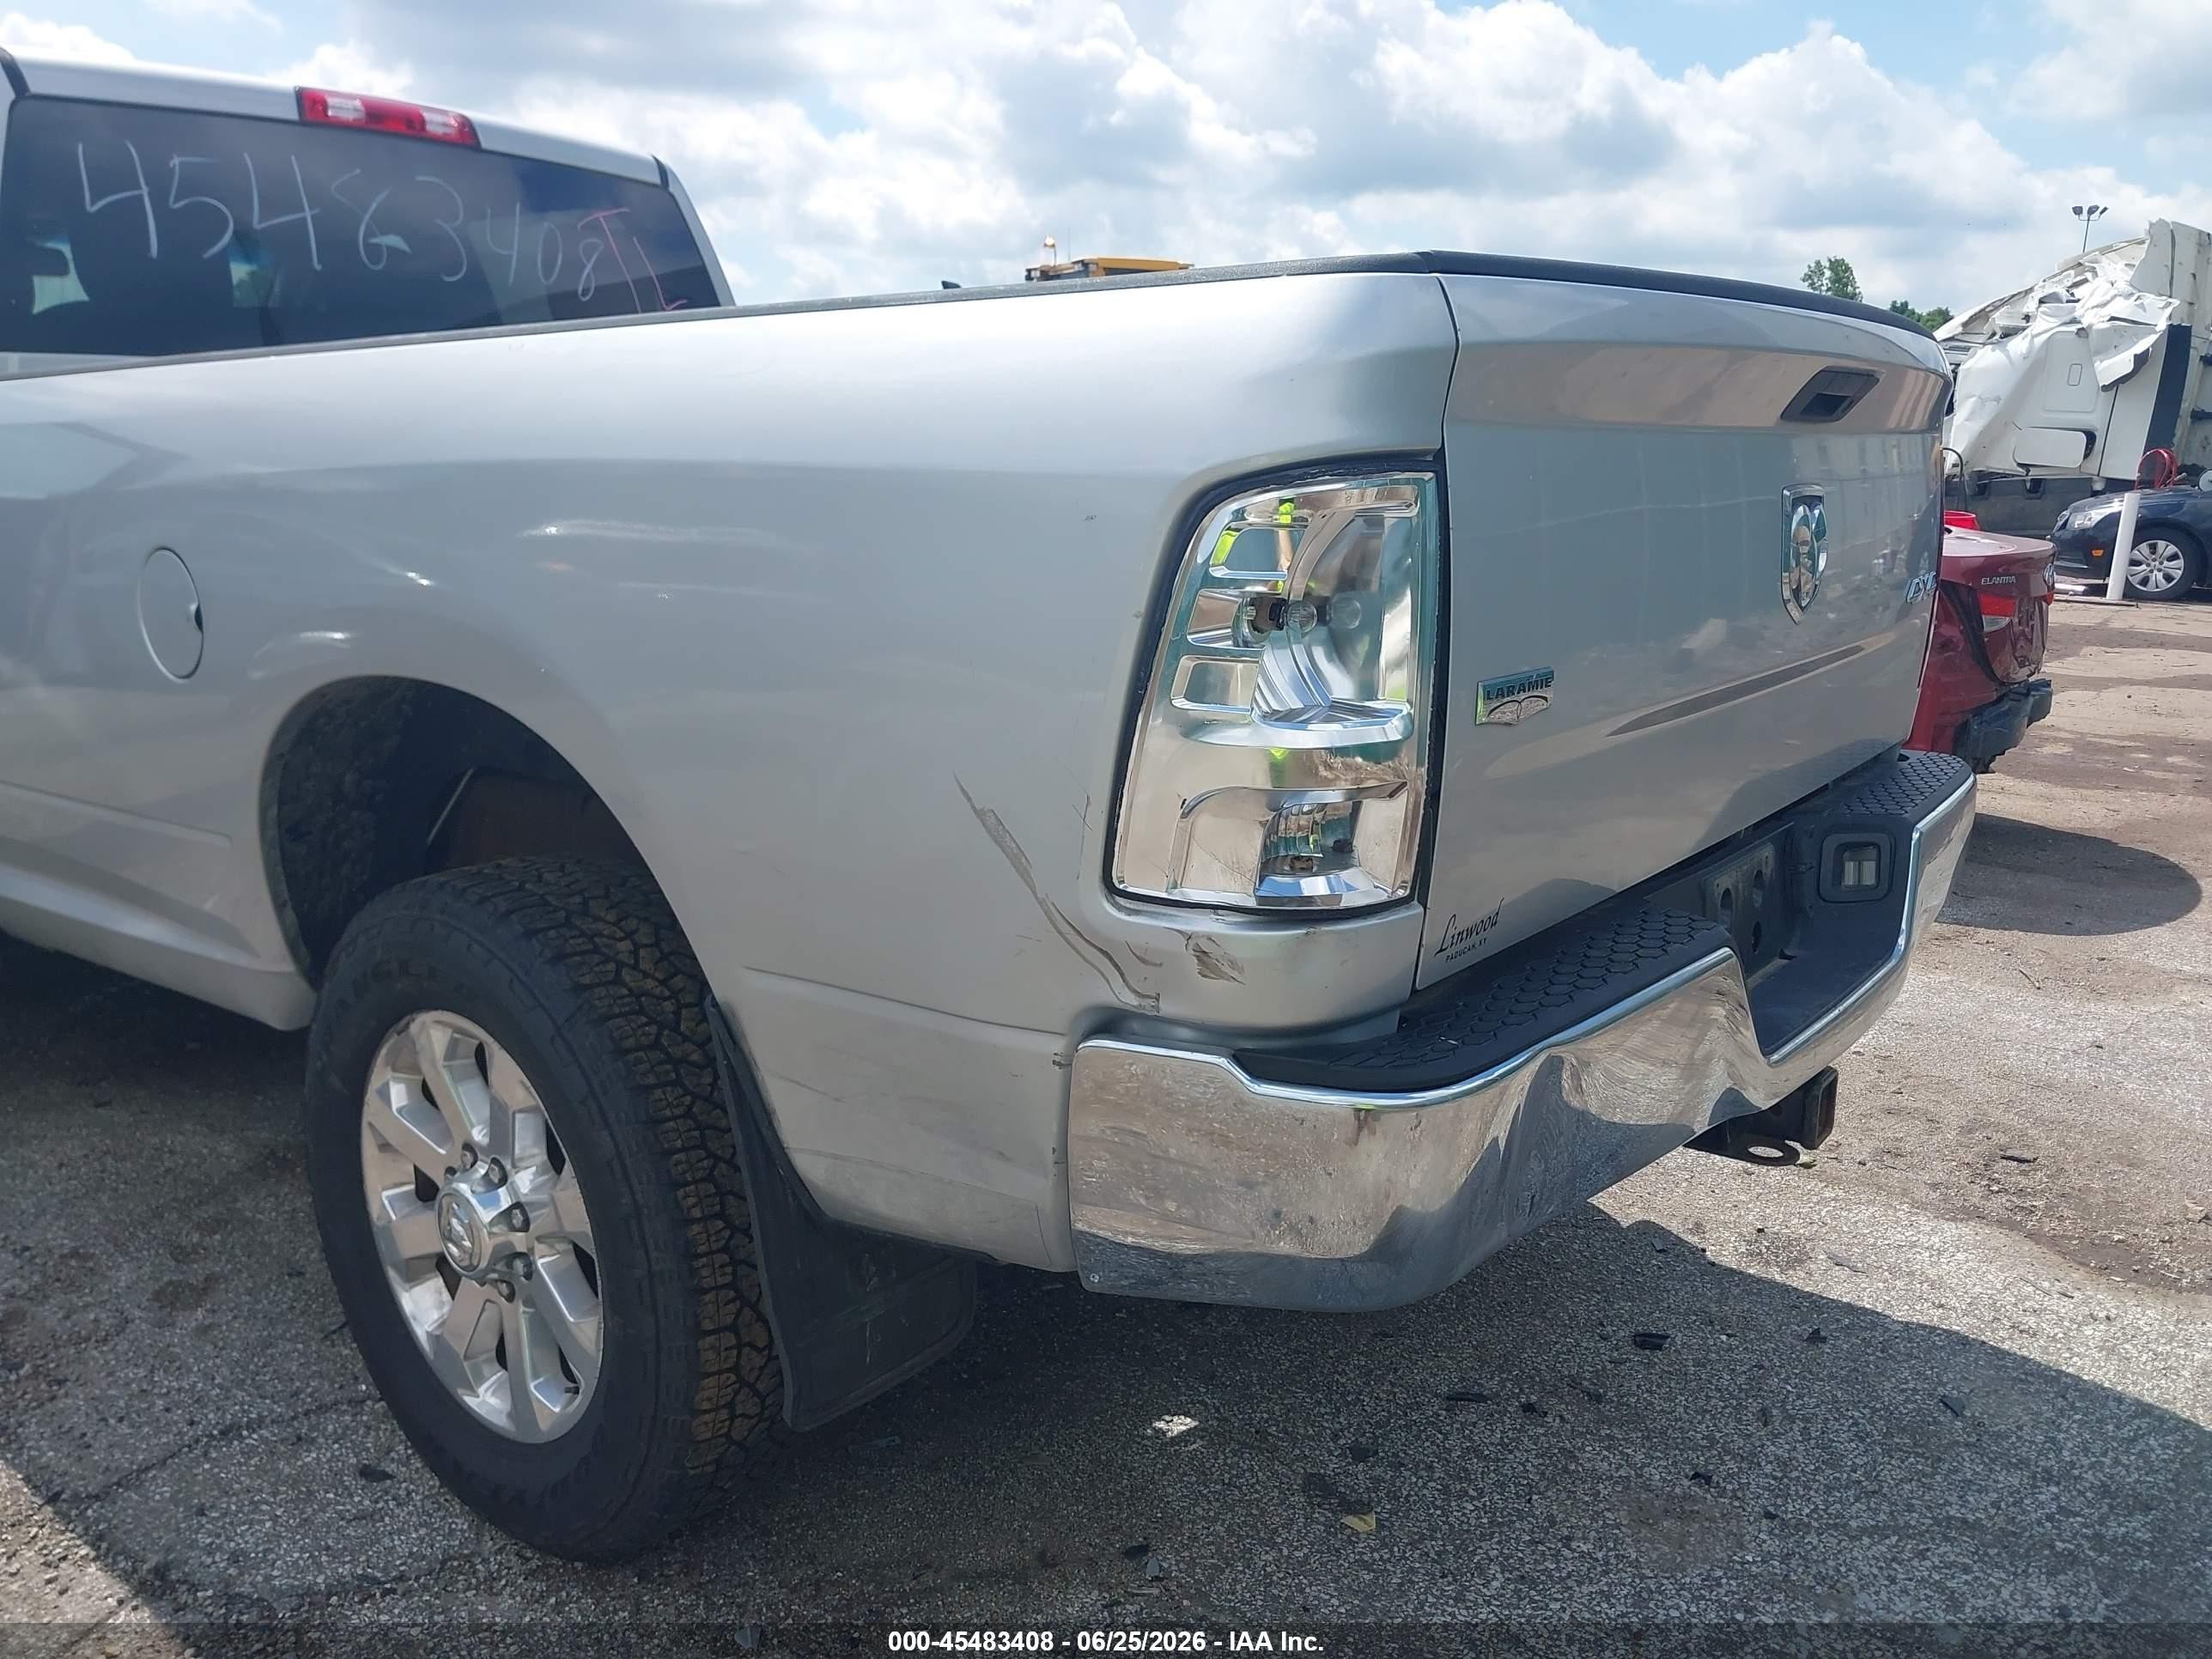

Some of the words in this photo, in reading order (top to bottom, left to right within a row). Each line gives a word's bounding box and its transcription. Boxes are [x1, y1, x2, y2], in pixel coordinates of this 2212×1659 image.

[1981, 575, 2016, 585] ELANTRA
[1486, 677, 1553, 701] LARAMIE
[1434, 897, 1504, 957] Linwood
